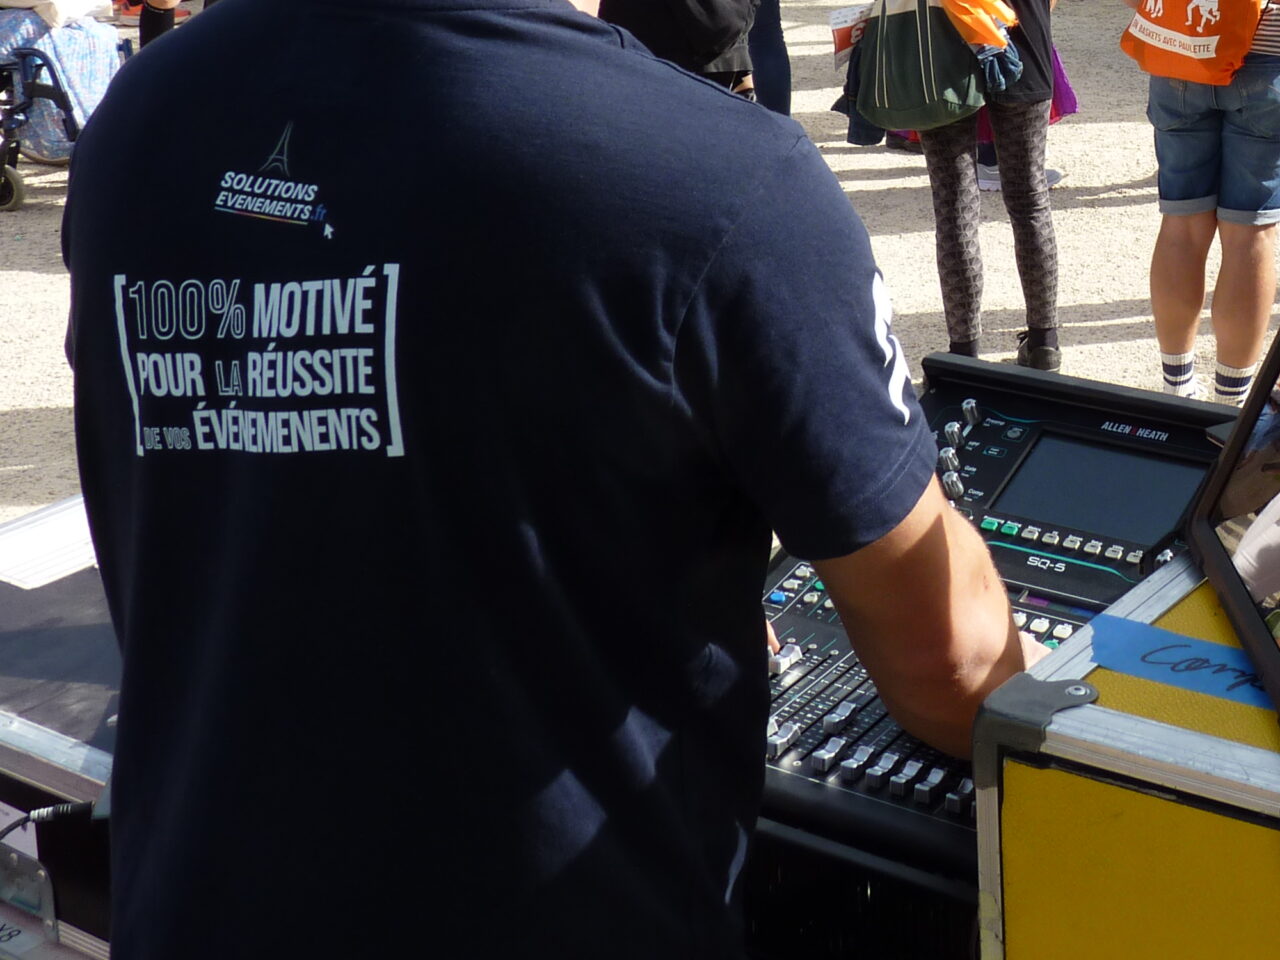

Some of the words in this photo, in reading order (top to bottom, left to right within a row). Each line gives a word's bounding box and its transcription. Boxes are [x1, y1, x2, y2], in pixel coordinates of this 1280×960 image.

[1139, 24, 1161, 42] BASKETS
[1162, 36, 1177, 48] AVEC
[1178, 40, 1211, 54] PAULETTE
[221, 171, 318, 201] SOLUTIONS
[129, 279, 245, 340] 100%
[253, 265, 376, 338] MOTIVÉ
[137, 352, 205, 397] POUR
[215, 360, 243, 396] LA
[248, 342, 375, 397] RÉUSSITE
[144, 427, 161, 450] DE
[163, 427, 191, 450] VOS
[1026, 556, 1066, 573] SQ-5
